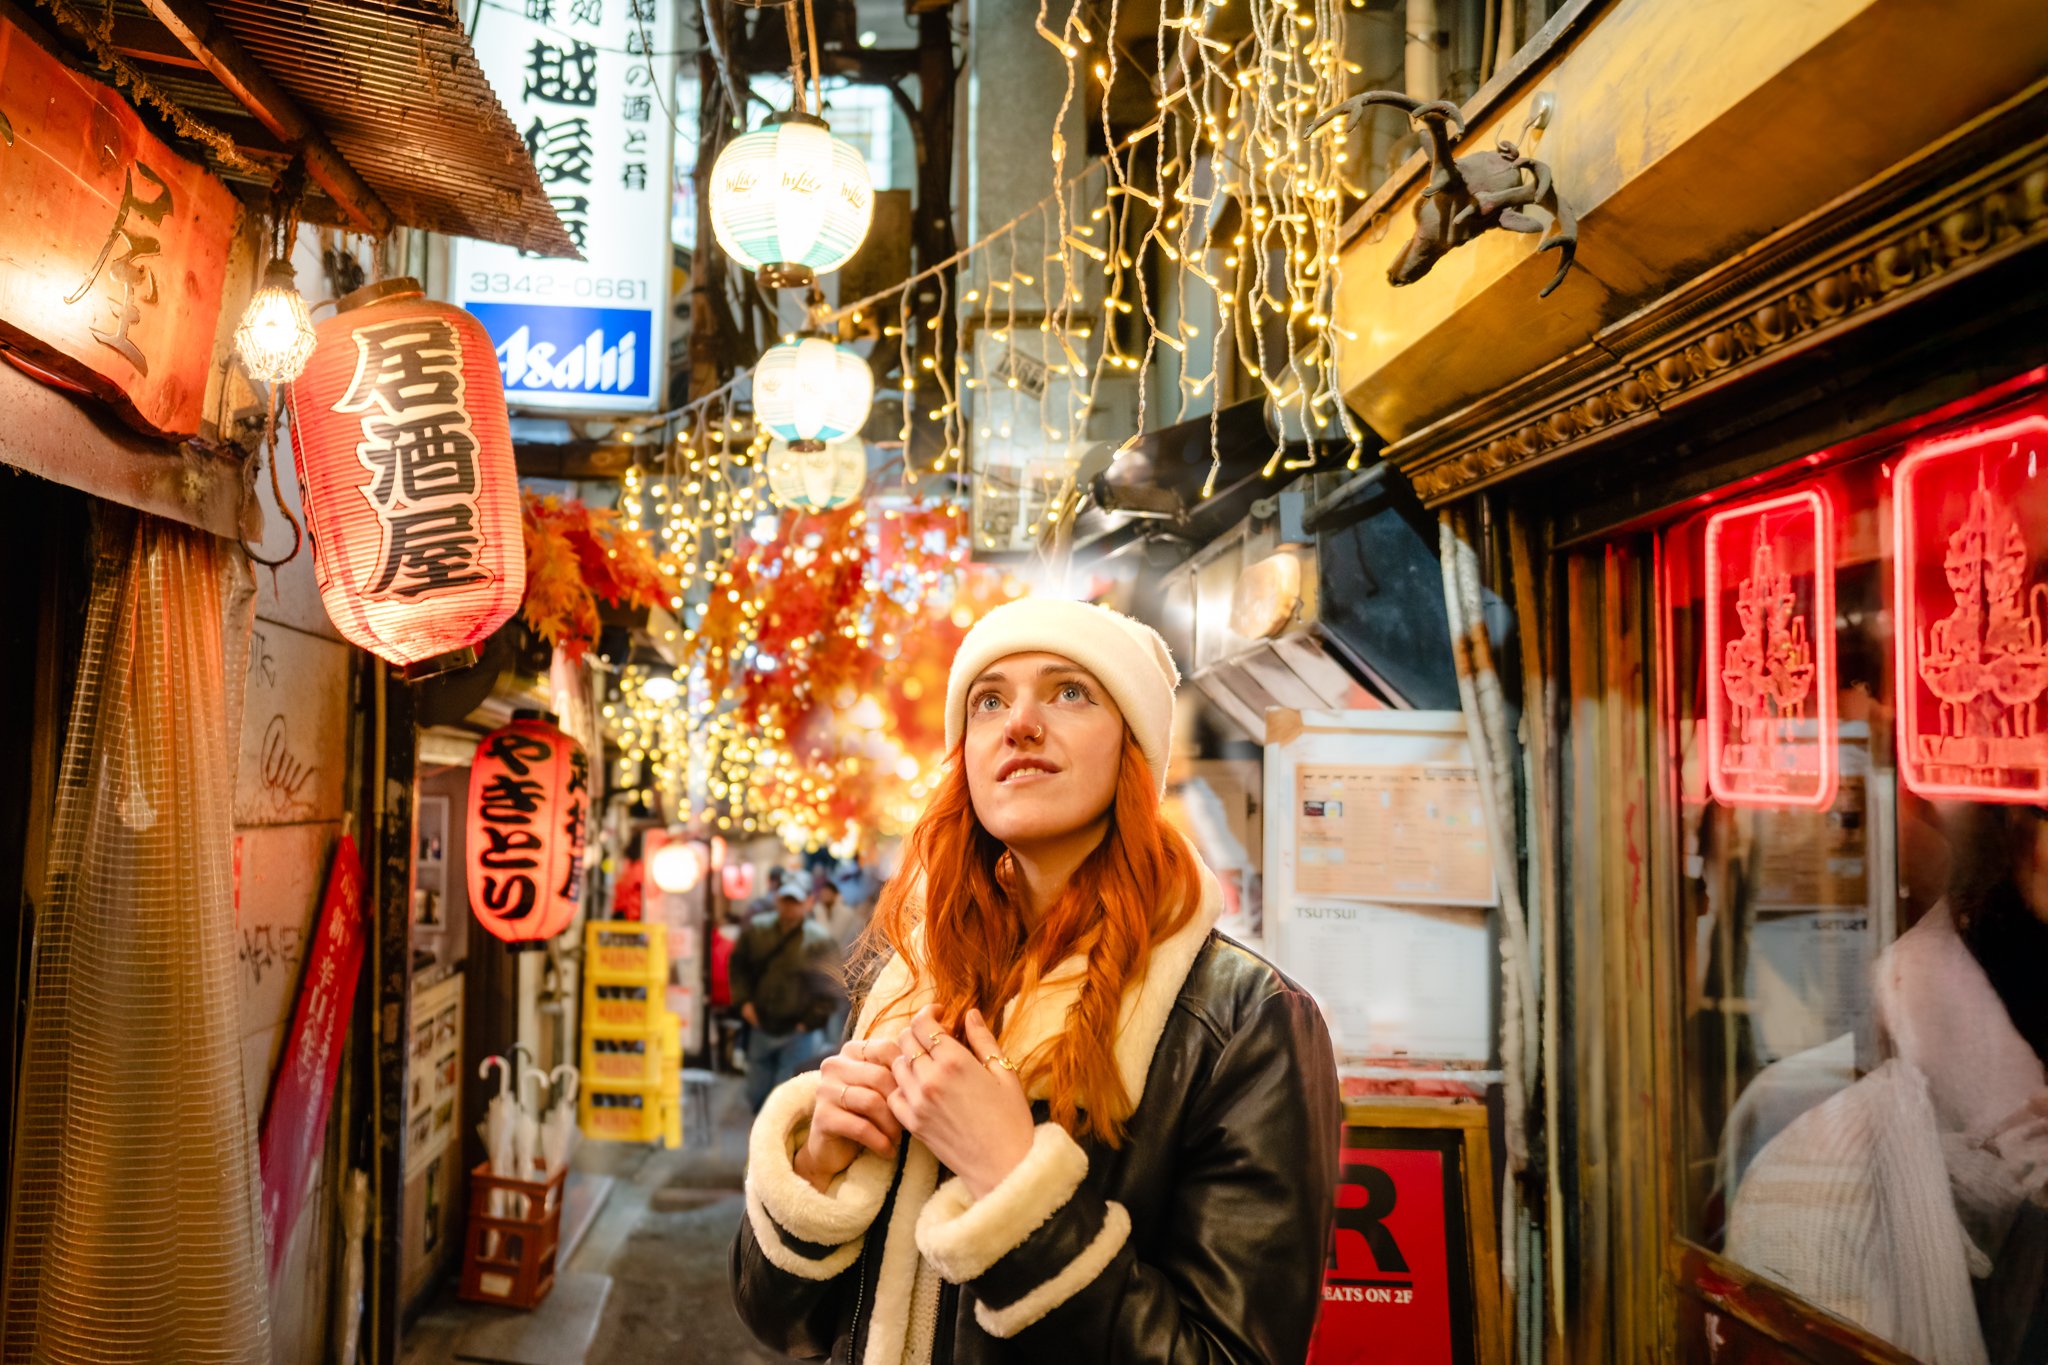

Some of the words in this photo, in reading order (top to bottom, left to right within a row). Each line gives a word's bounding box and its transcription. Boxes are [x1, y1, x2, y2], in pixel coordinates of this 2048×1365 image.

[469, 271, 648, 300] 3342-0661
[495, 324, 636, 392] Asahi
[336, 319, 491, 600] 居酒屋
[480, 734, 553, 920] やきとり
[1296, 907, 1357, 920] TSUTSUI
[1365, 1288, 1391, 1303] ON
[1394, 1290, 1413, 1304] 2F
